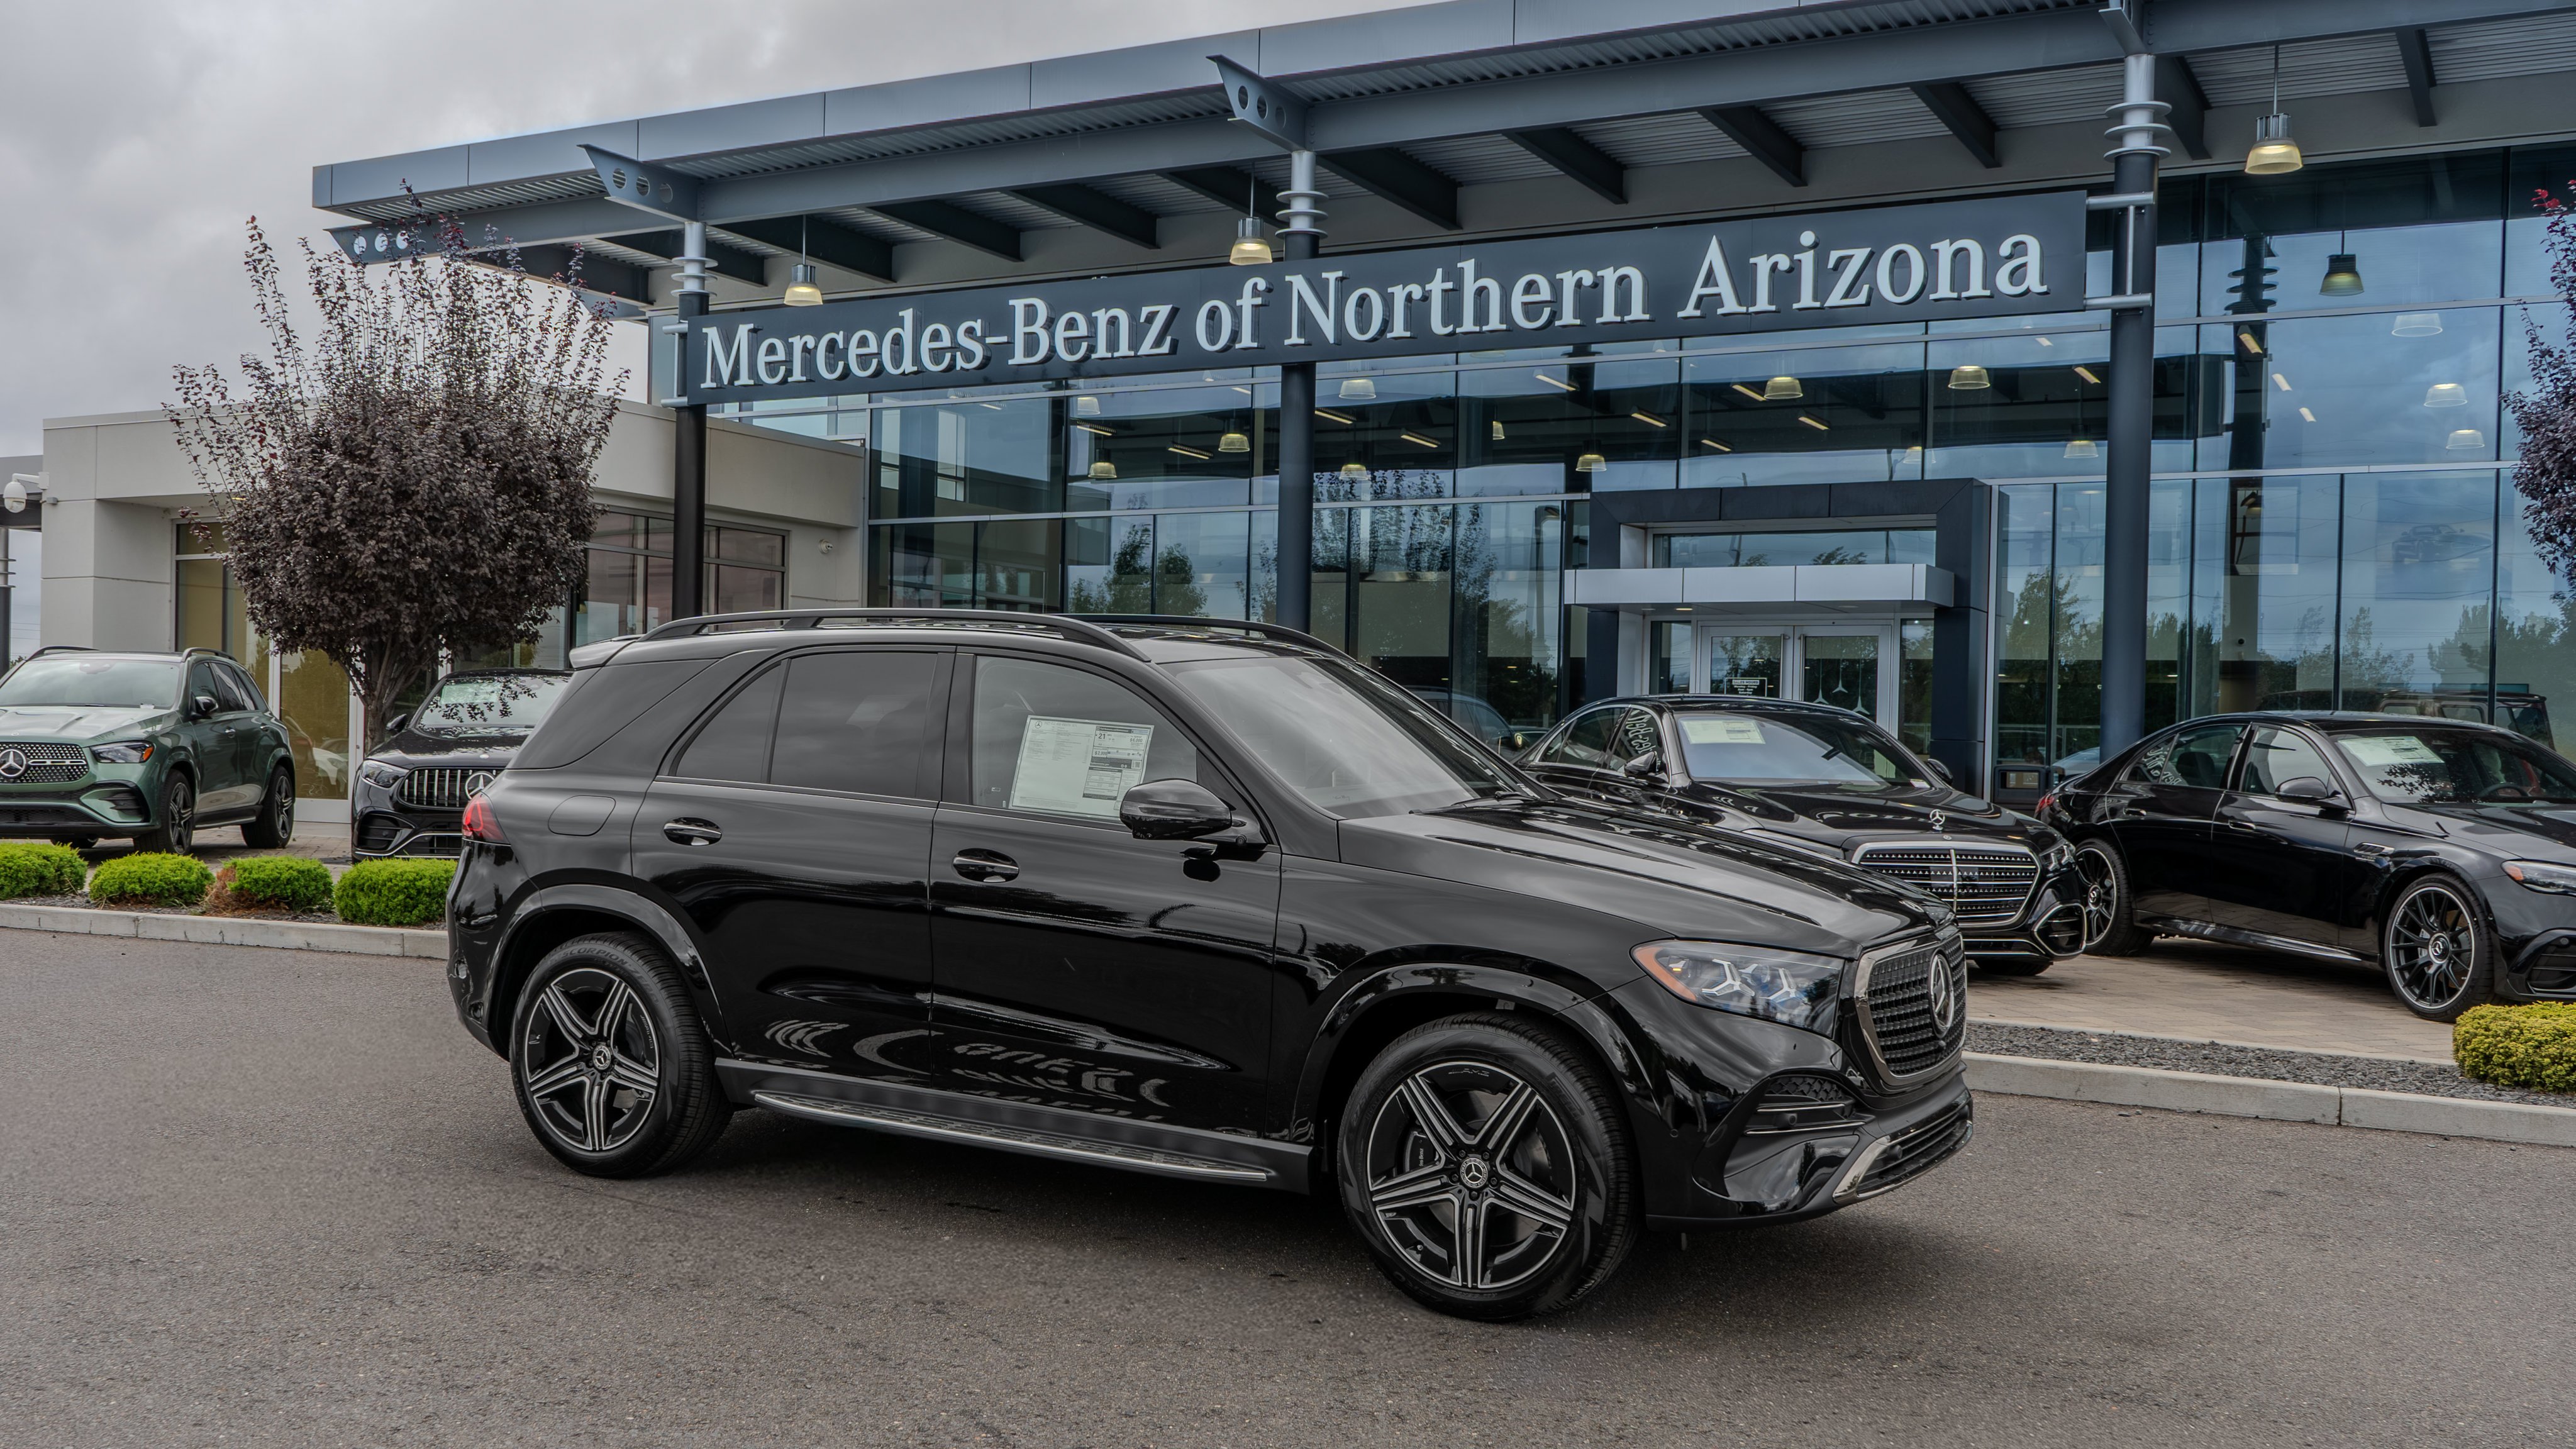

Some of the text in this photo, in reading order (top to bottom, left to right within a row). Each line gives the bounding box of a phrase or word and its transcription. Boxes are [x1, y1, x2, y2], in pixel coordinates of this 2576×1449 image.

[700, 230, 2048, 389] Mercedes-Benz of Northern Arizona
[562, 947, 628, 967] SCORPION
